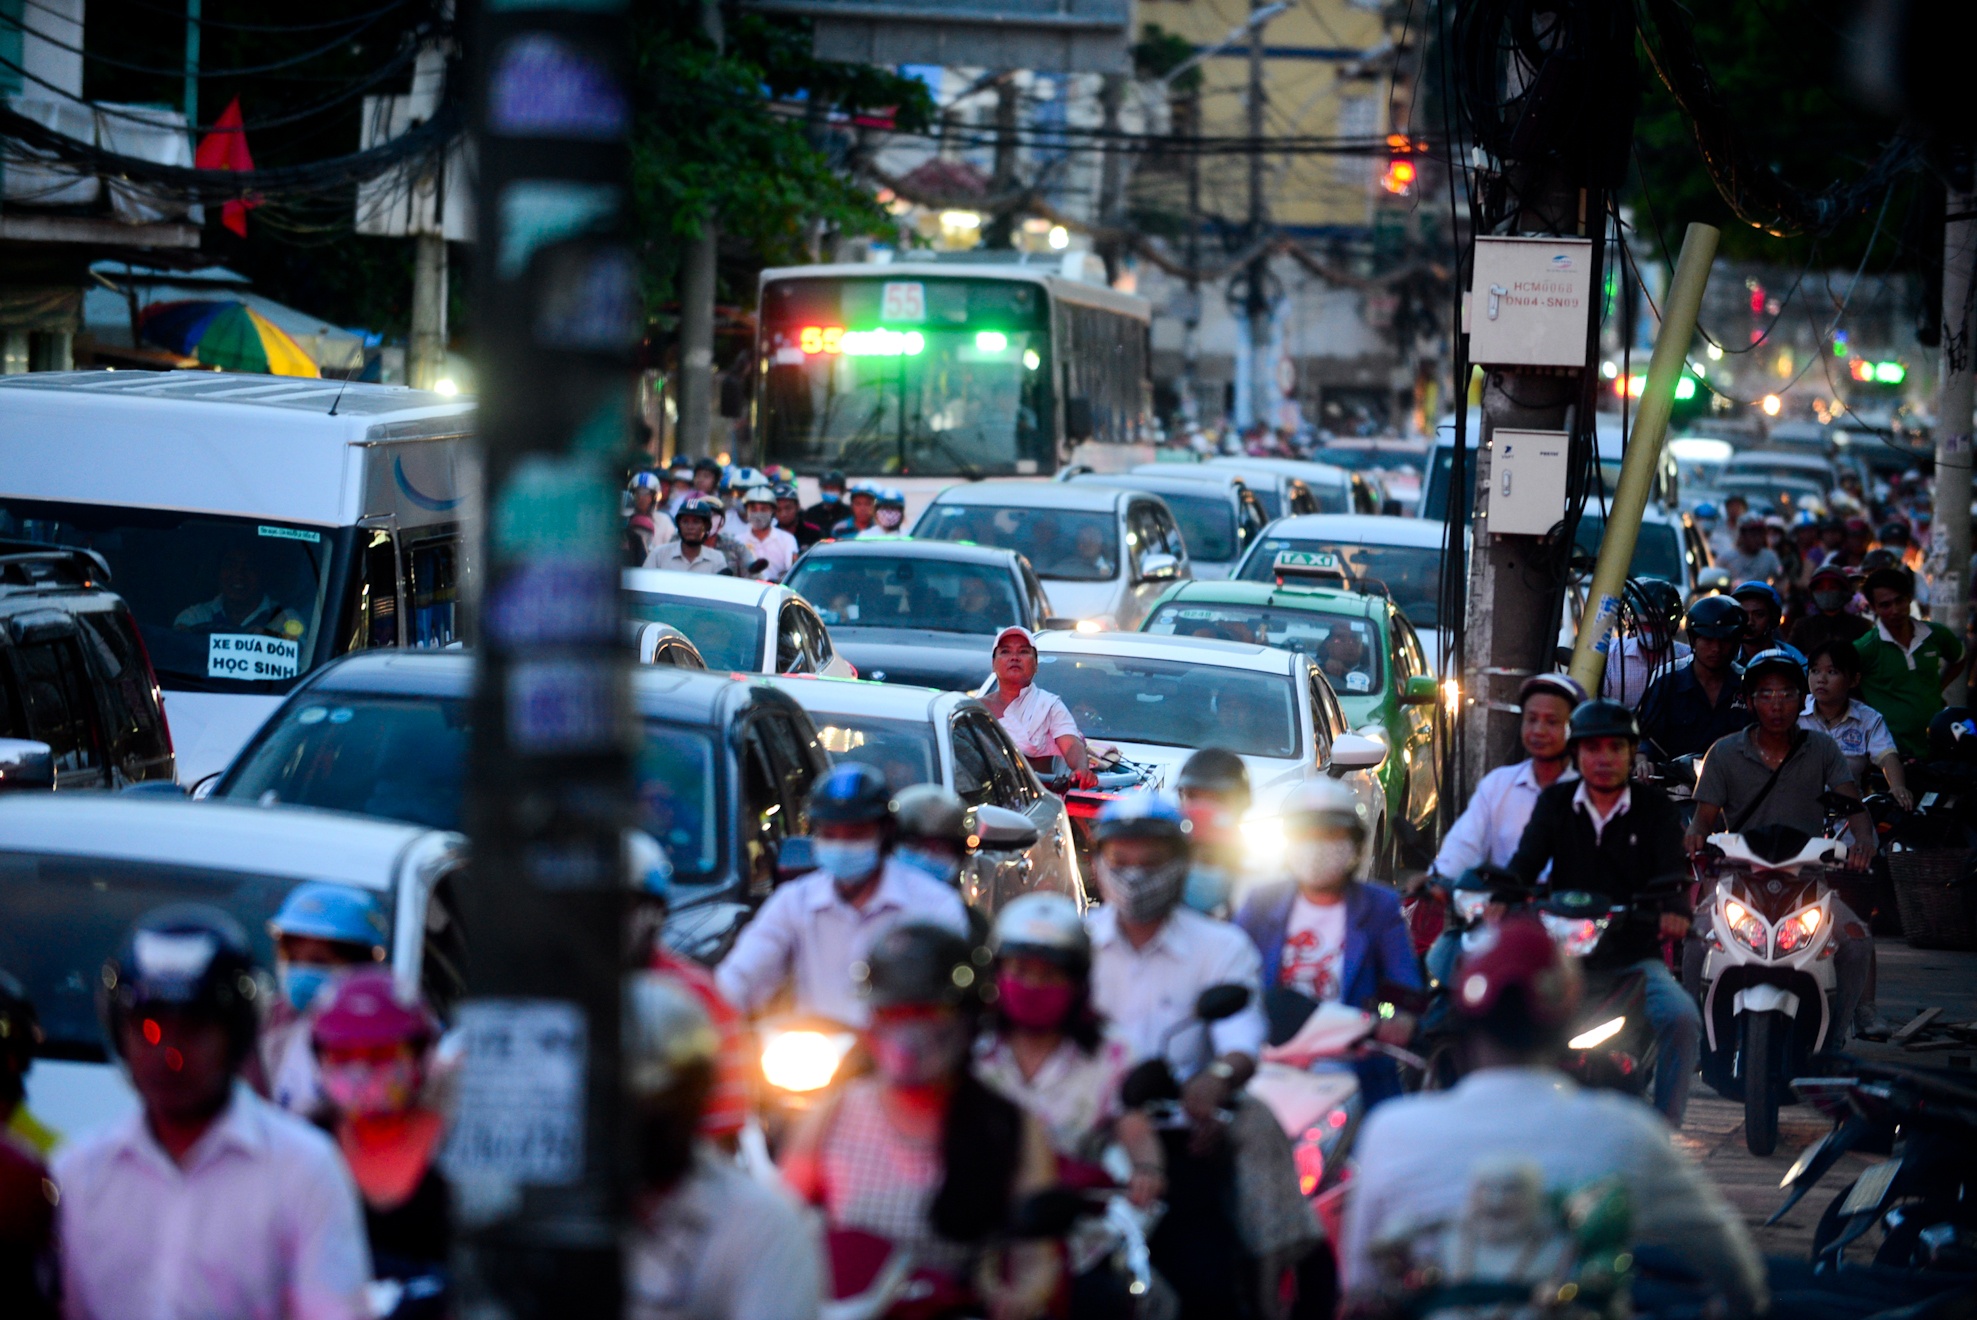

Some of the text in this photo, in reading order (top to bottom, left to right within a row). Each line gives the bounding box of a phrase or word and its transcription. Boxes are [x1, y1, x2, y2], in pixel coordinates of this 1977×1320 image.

[887, 284, 922, 318] 55
[800, 326, 845, 354] 55
[213, 638, 295, 658] XE ĐƯA ĐÓN
[213, 657, 294, 679] HỌC SINH
